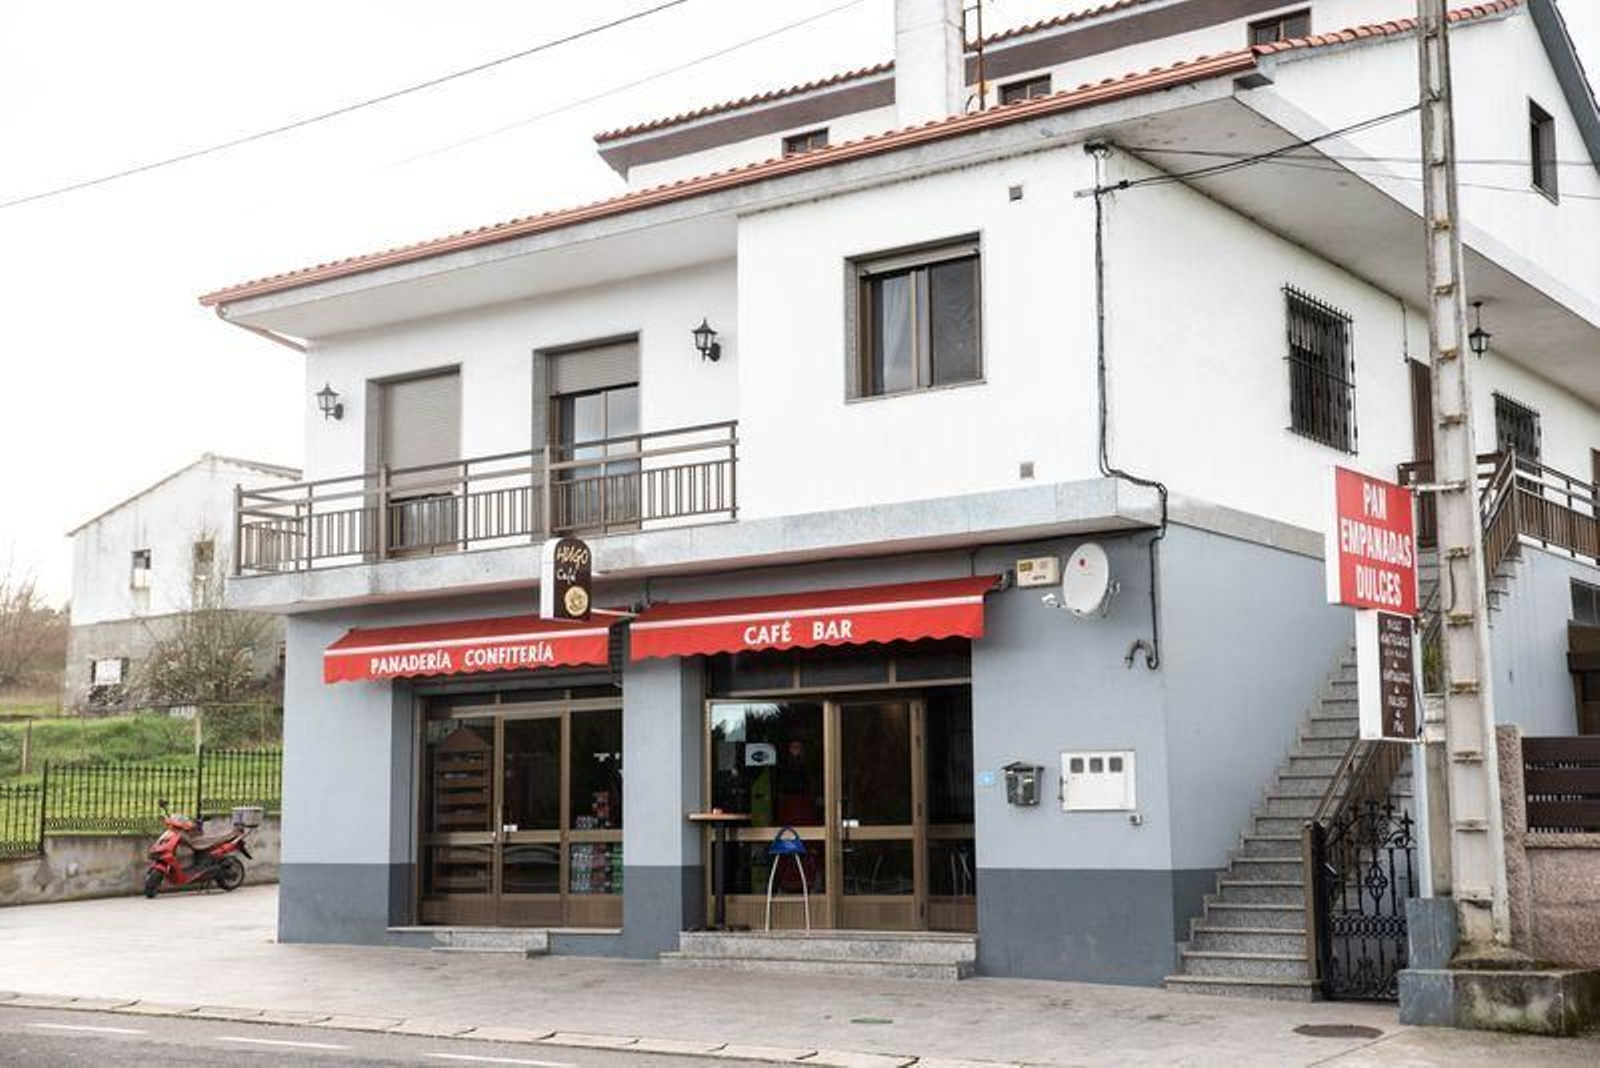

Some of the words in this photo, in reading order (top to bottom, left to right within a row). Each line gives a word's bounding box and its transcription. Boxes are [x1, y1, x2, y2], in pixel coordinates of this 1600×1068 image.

[1363, 481, 1386, 520] PAN
[1341, 517, 1412, 568] EMPANADAS
[1356, 564, 1402, 607] DULCES
[744, 620, 792, 644] CAFÉ
[813, 619, 853, 640] BAR
[370, 650, 452, 674] PANADERÍA
[464, 641, 554, 666] CONFITERÍA
